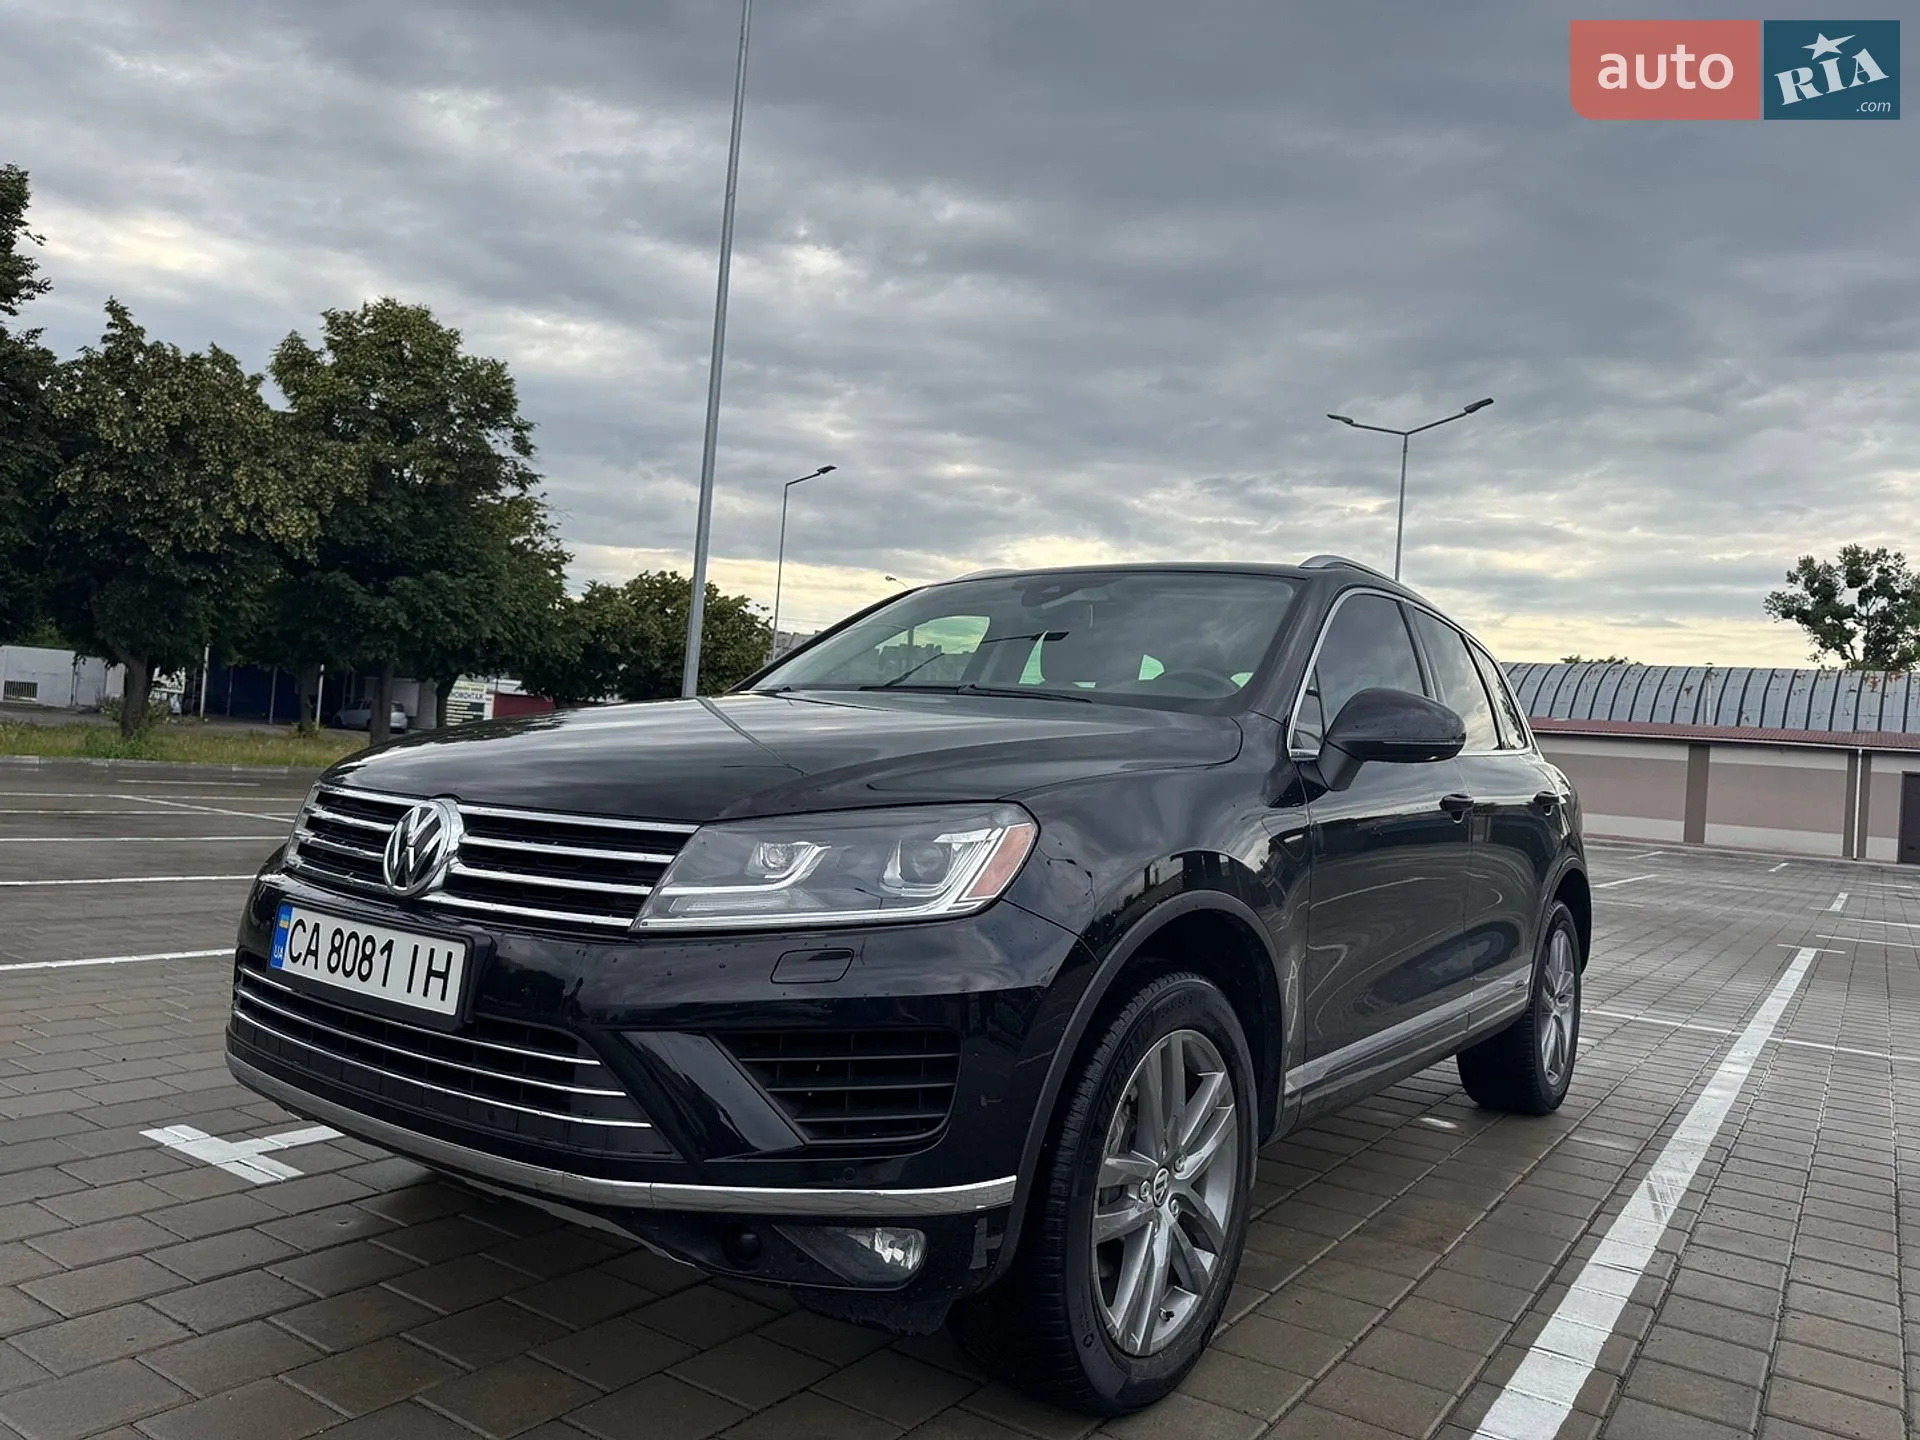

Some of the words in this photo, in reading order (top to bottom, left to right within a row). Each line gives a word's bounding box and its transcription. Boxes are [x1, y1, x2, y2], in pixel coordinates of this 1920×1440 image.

[273, 944, 284, 960] UA
[288, 918, 320, 970] CA
[327, 927, 395, 988] 8081
[406, 943, 453, 1002] IH
